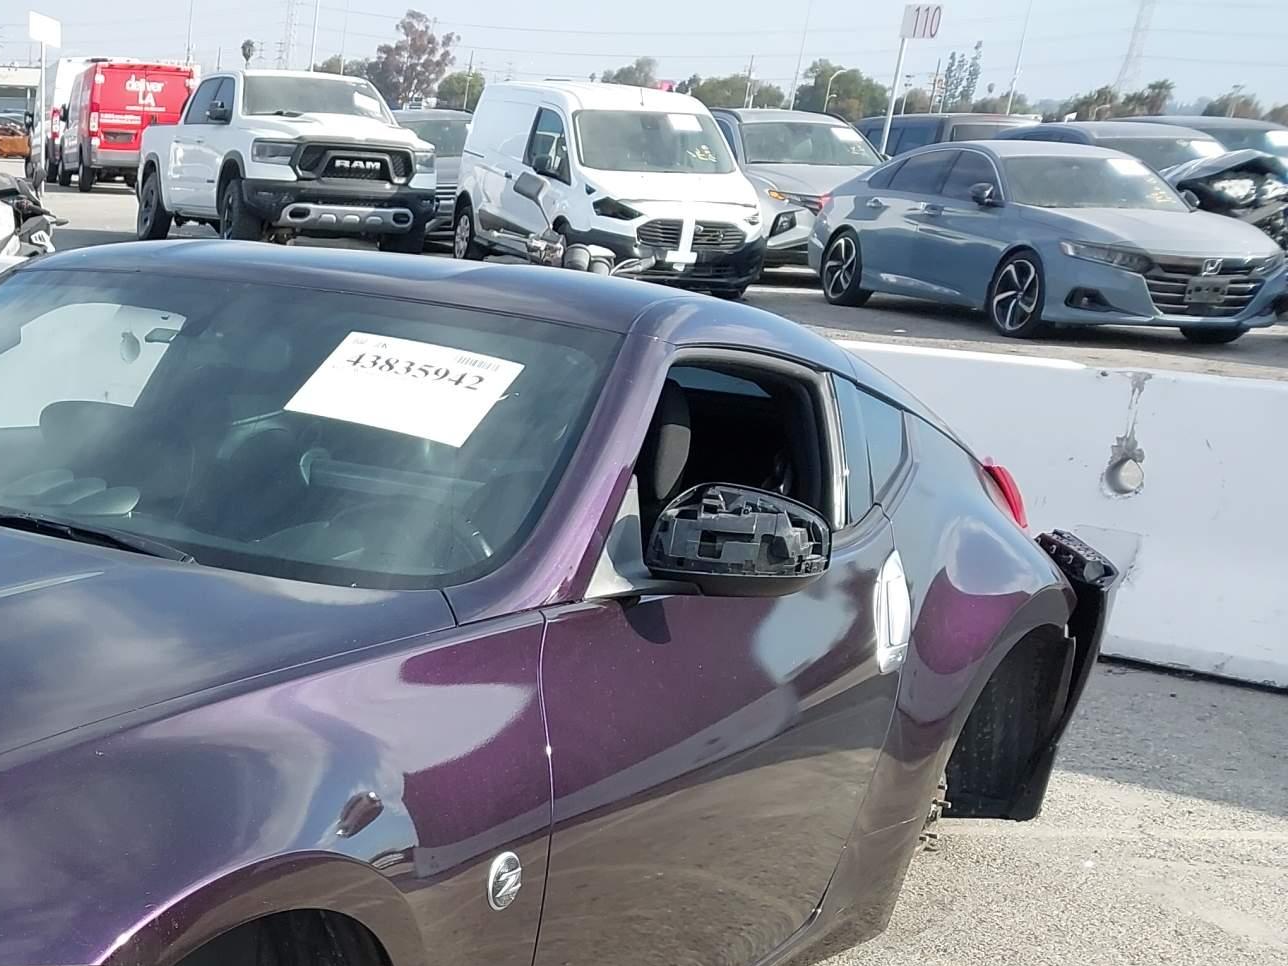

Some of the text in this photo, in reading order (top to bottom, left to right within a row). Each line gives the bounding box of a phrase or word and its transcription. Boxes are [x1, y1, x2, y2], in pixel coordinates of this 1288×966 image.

[912, 5, 942, 39] 110
[138, 91, 156, 107] LA
[334, 159, 381, 170] RAM
[346, 352, 485, 391] 43835942
